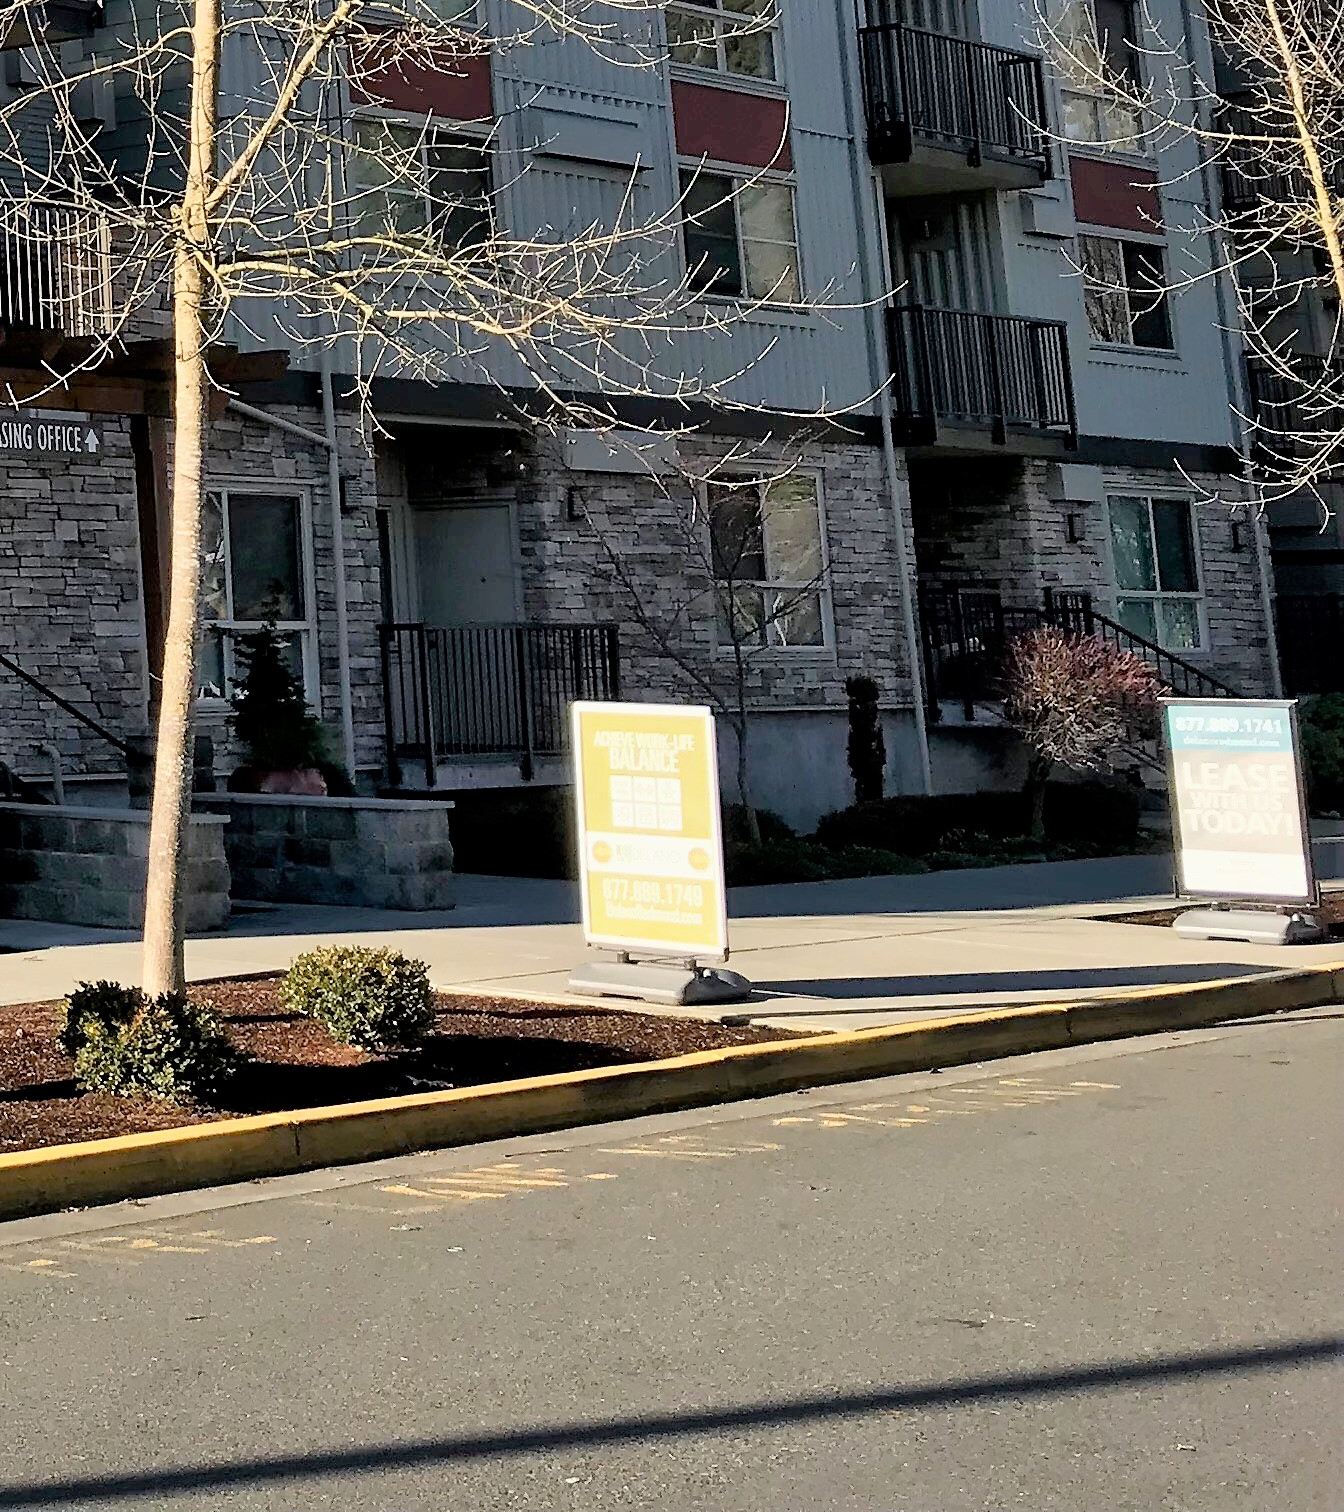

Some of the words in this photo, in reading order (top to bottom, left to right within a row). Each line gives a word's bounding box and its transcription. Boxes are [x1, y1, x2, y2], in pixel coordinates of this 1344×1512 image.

[37, 424, 82, 453] OFFICE
[609, 747, 680, 773] BALANCE
[1182, 761, 1291, 794] LEASE
[1189, 791, 1248, 810] WITH
[1253, 793, 1284, 812] US
[1183, 808, 1295, 837] TODAY!
